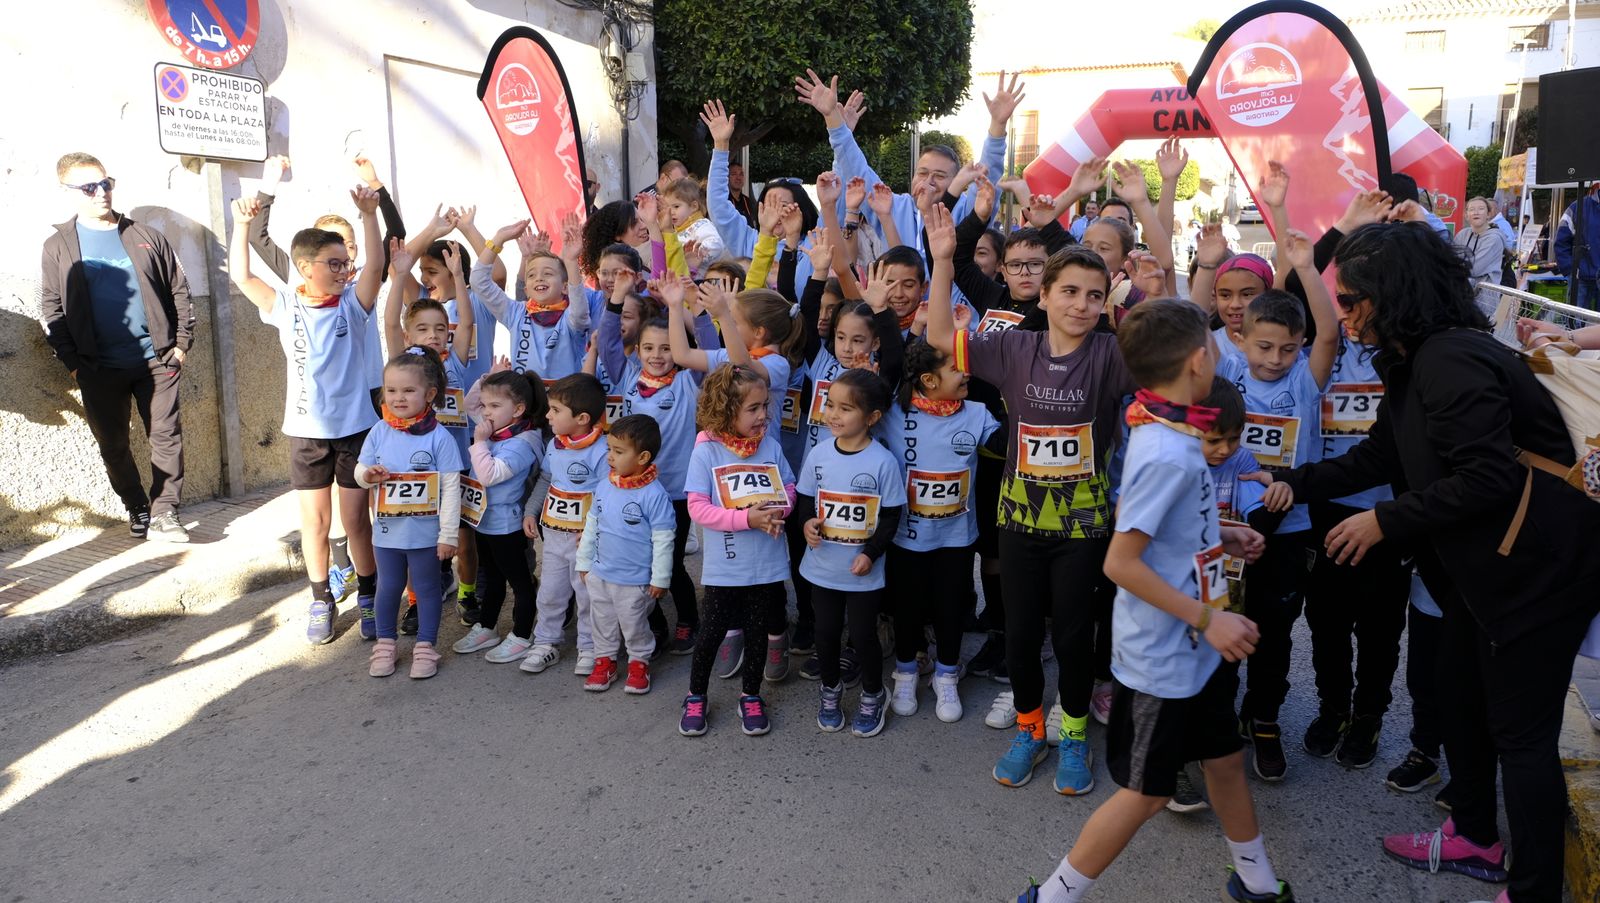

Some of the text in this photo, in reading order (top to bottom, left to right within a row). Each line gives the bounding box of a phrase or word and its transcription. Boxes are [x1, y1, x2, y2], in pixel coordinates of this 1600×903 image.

[165, 26, 183, 47] de
[184, 43, 195, 55] 7
[212, 58, 222, 67] a
[224, 49, 240, 65] 15
[191, 73, 262, 94] PROHIBIDO
[199, 97, 259, 113] ESTACIONAR
[208, 89, 248, 102] PARAR Y
[160, 105, 264, 128] EN TODA LA PLAZA
[164, 129, 185, 138] hasta
[186, 131, 194, 139] el
[195, 133, 217, 142] Lunes
[224, 135, 235, 144] las
[171, 122, 182, 130] de
[183, 123, 211, 134] Viernes
[218, 127, 229, 136] las
[1030, 402, 1055, 411] STONE
[904, 410, 919, 431] LA
[1028, 438, 1079, 457] 710
[386, 483, 426, 498] 727
[727, 473, 772, 492] 748
[917, 482, 960, 499] 724
[459, 485, 483, 506] 732
[548, 496, 580, 515] 721
[824, 503, 866, 522] 749
